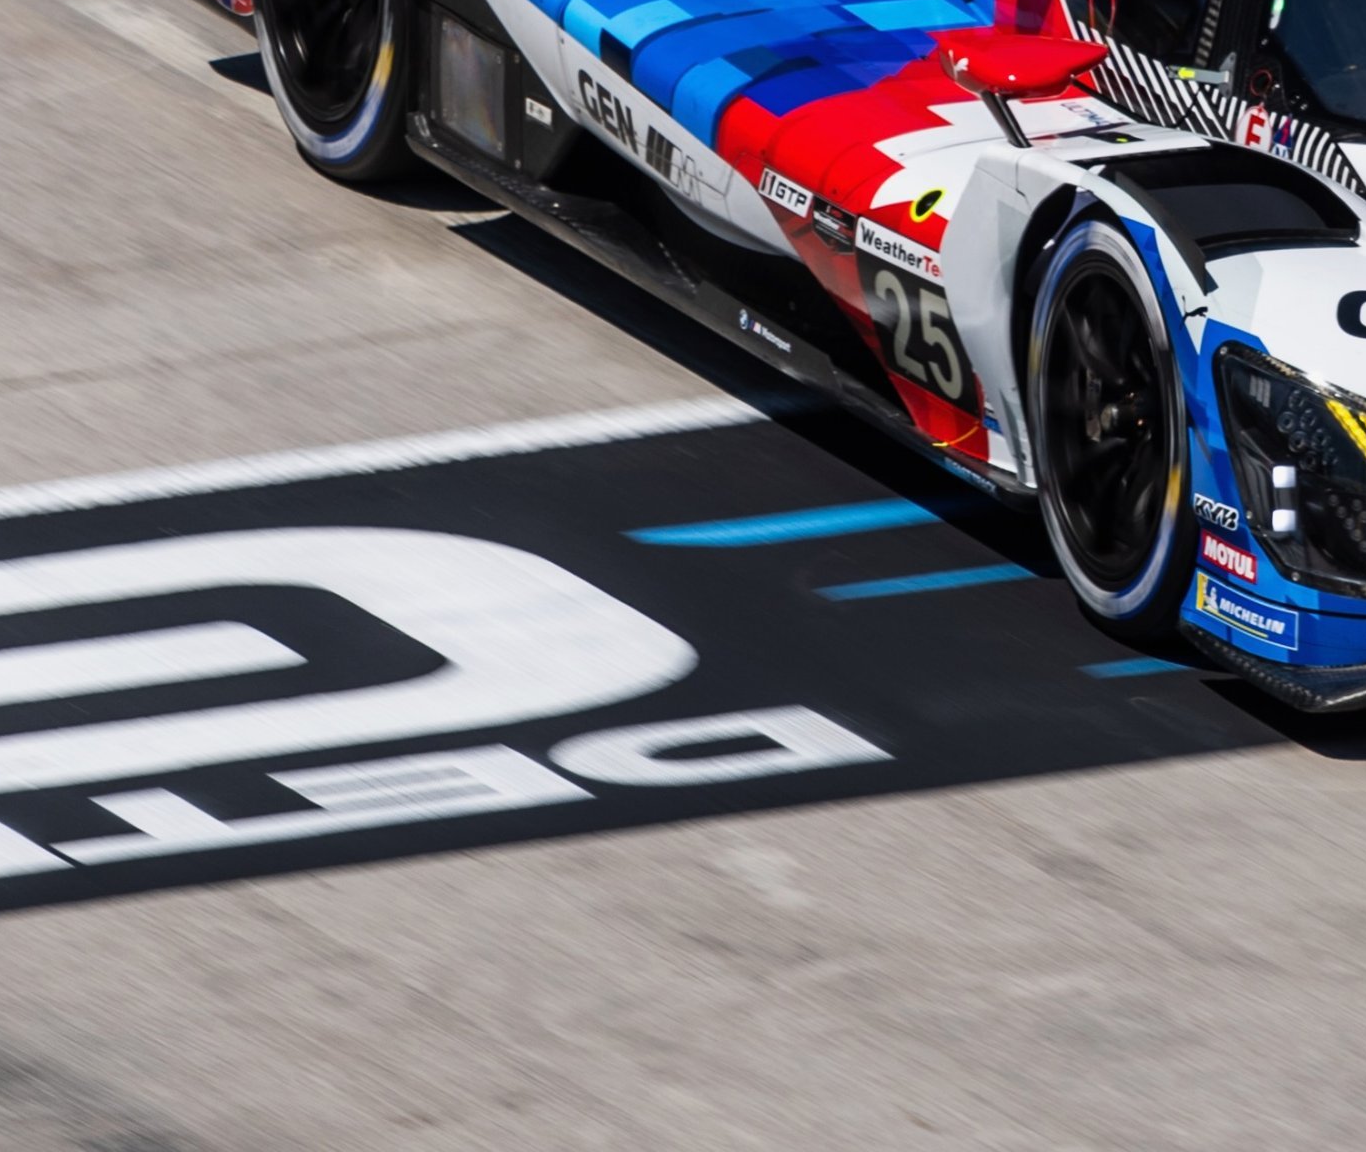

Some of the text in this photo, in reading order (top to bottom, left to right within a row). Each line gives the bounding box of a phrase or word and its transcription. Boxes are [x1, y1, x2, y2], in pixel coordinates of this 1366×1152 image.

[578, 68, 638, 156] GEN
[774, 182, 808, 208] GTP
[859, 221, 944, 279] WeatherTe
[874, 269, 963, 400] 25
[1204, 535, 1255, 580] MOTUL
[1218, 598, 1286, 635] MICHELIN
